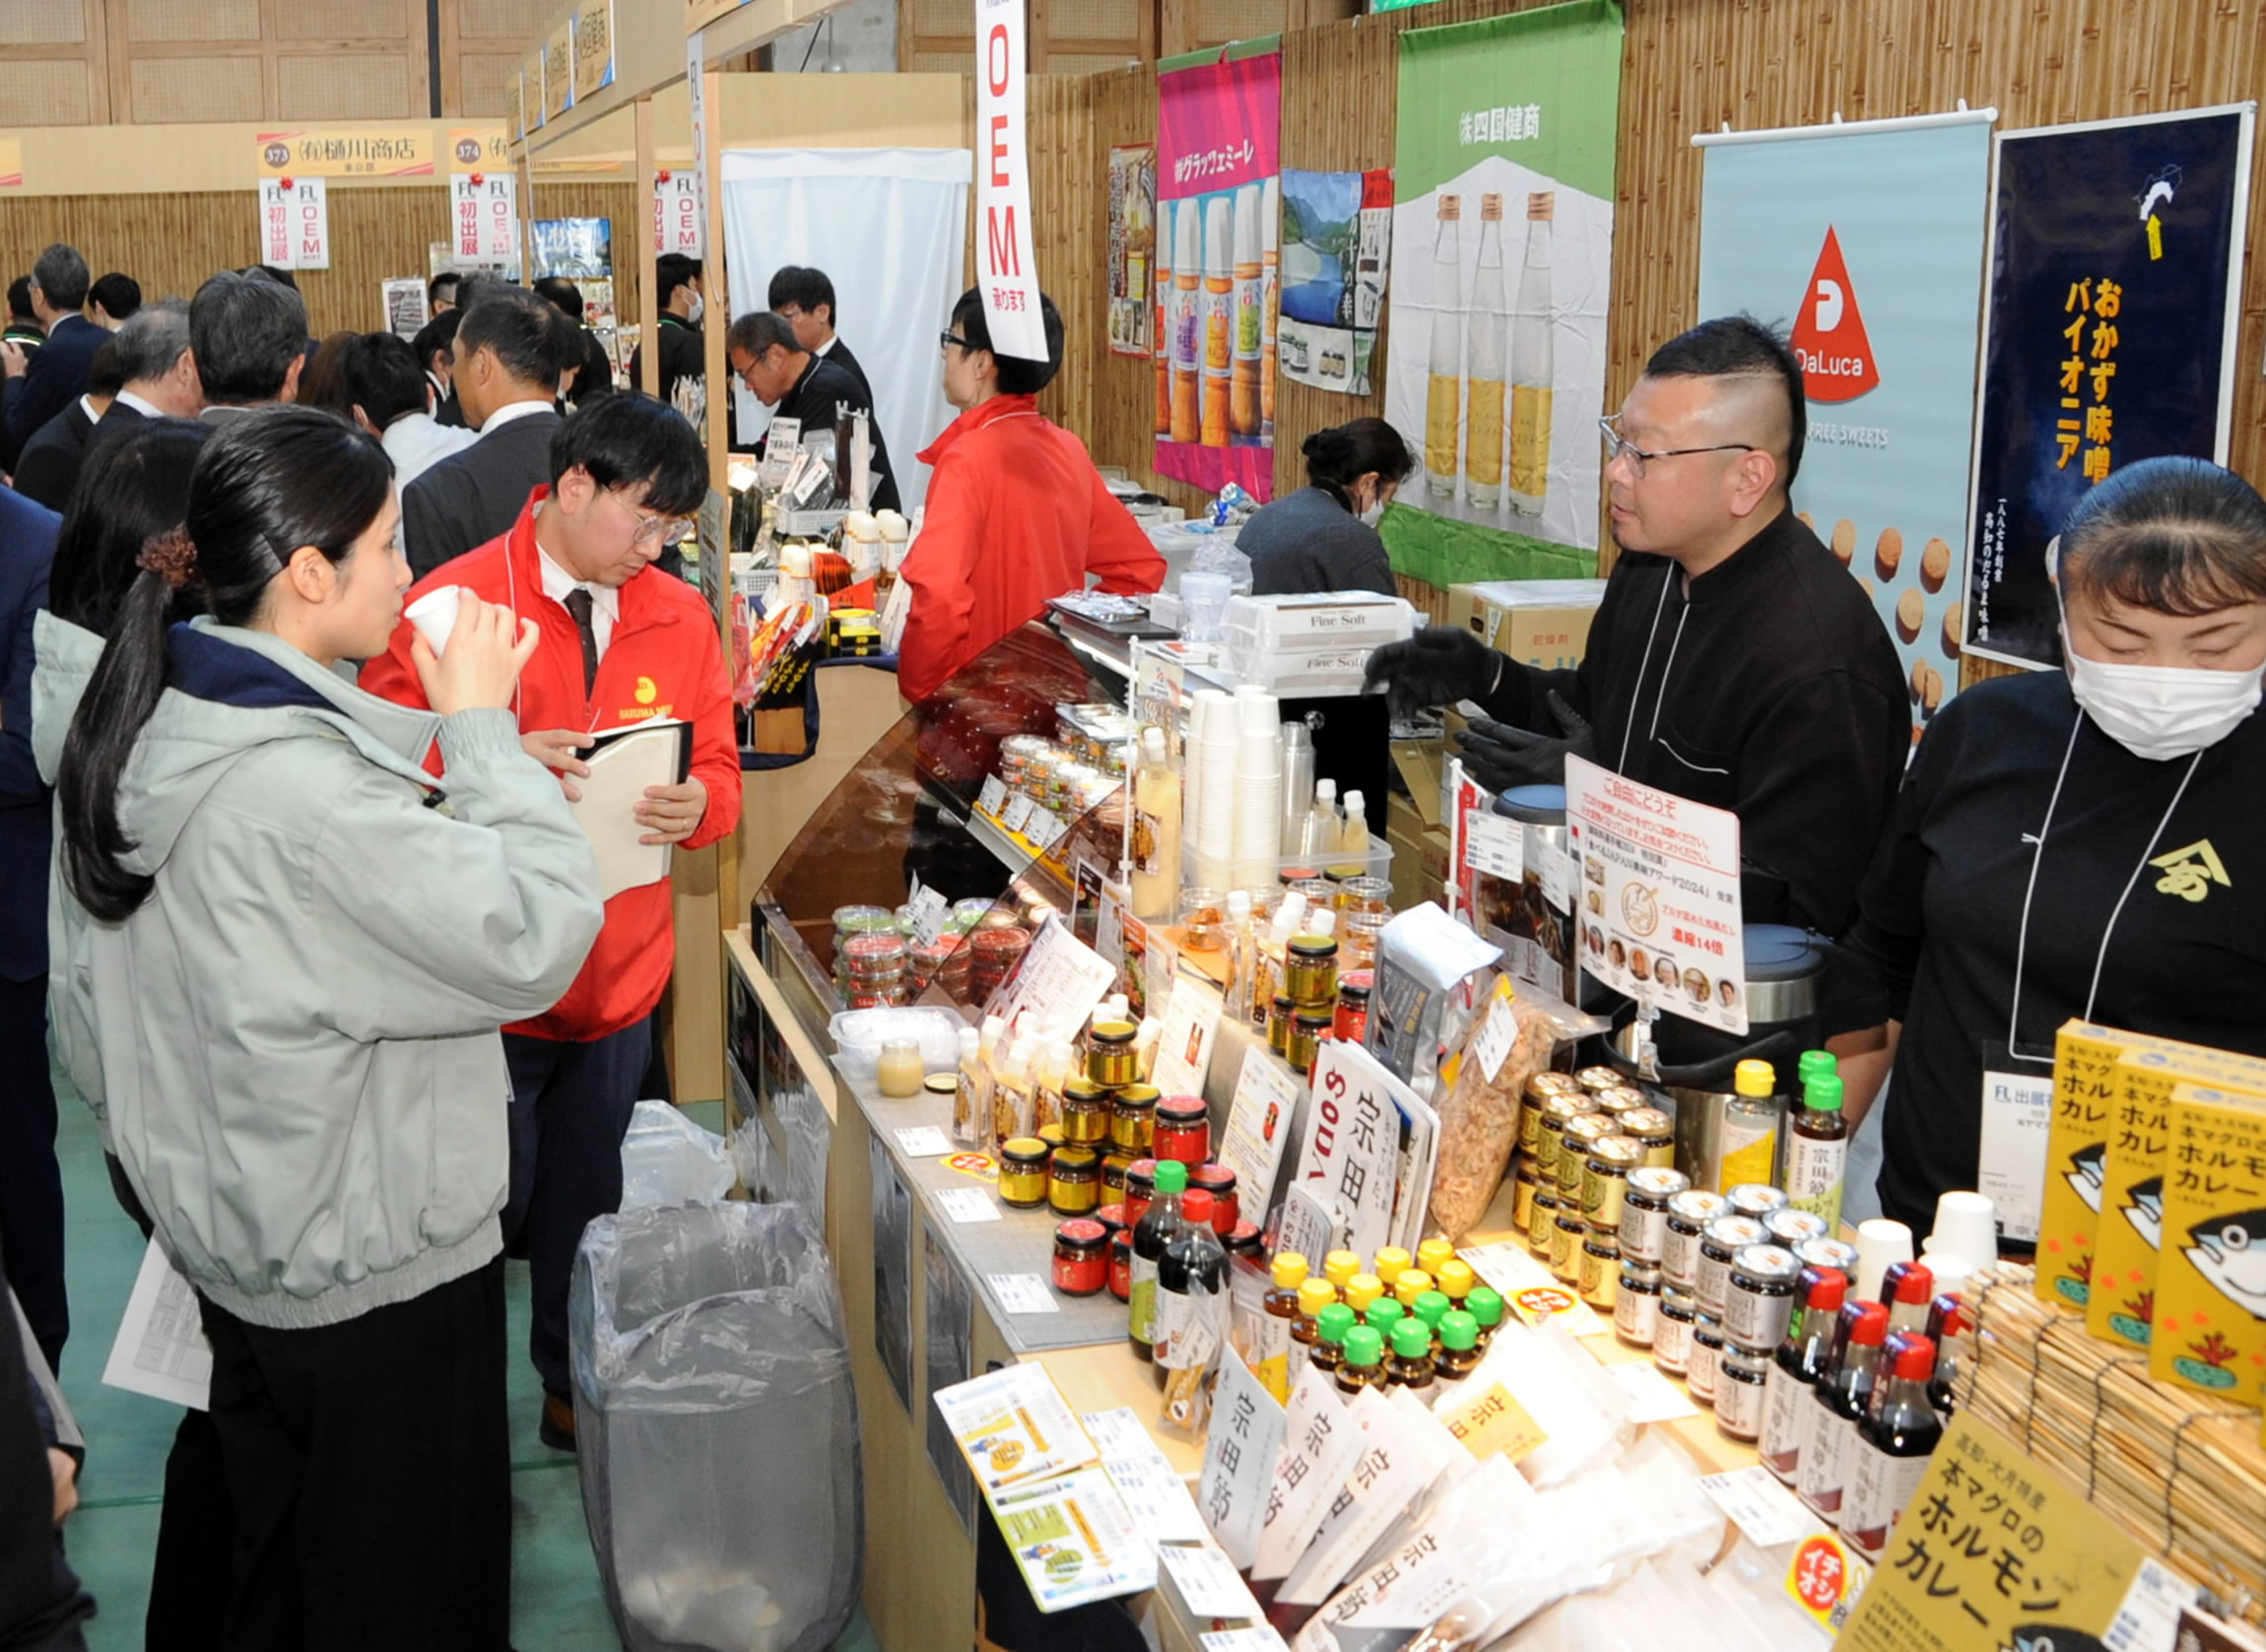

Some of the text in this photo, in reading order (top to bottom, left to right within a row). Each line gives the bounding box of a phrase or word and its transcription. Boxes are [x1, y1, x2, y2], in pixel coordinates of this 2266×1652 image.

[265, 149, 289, 163] 373
[457, 145, 480, 159] 374
[987, 23, 1021, 277] OEM
[268, 205, 289, 261] 初出展
[301, 205, 321, 253] OEM
[459, 200, 478, 255] 初出展
[678, 198, 696, 244] OEM
[1794, 348, 1864, 377] DaLuca
[2055, 277, 2093, 470] パイオニア
[1839, 425, 1890, 446] SWEETS
[1310, 615, 1366, 628] Fine Soft
[1306, 659, 1334, 670] Fine
[2062, 1075, 2113, 1098] ホル
[2060, 1099, 2106, 1122] カレ
[2120, 1105, 2168, 1131] ホル
[2117, 1130, 2167, 1155] カレ
[2175, 1168, 2260, 1198] カレー
[1940, 1458, 2044, 1553] 本マグロの
[1920, 1494, 2061, 1612] ホルモン
[1894, 1539, 1989, 1629] カレー
